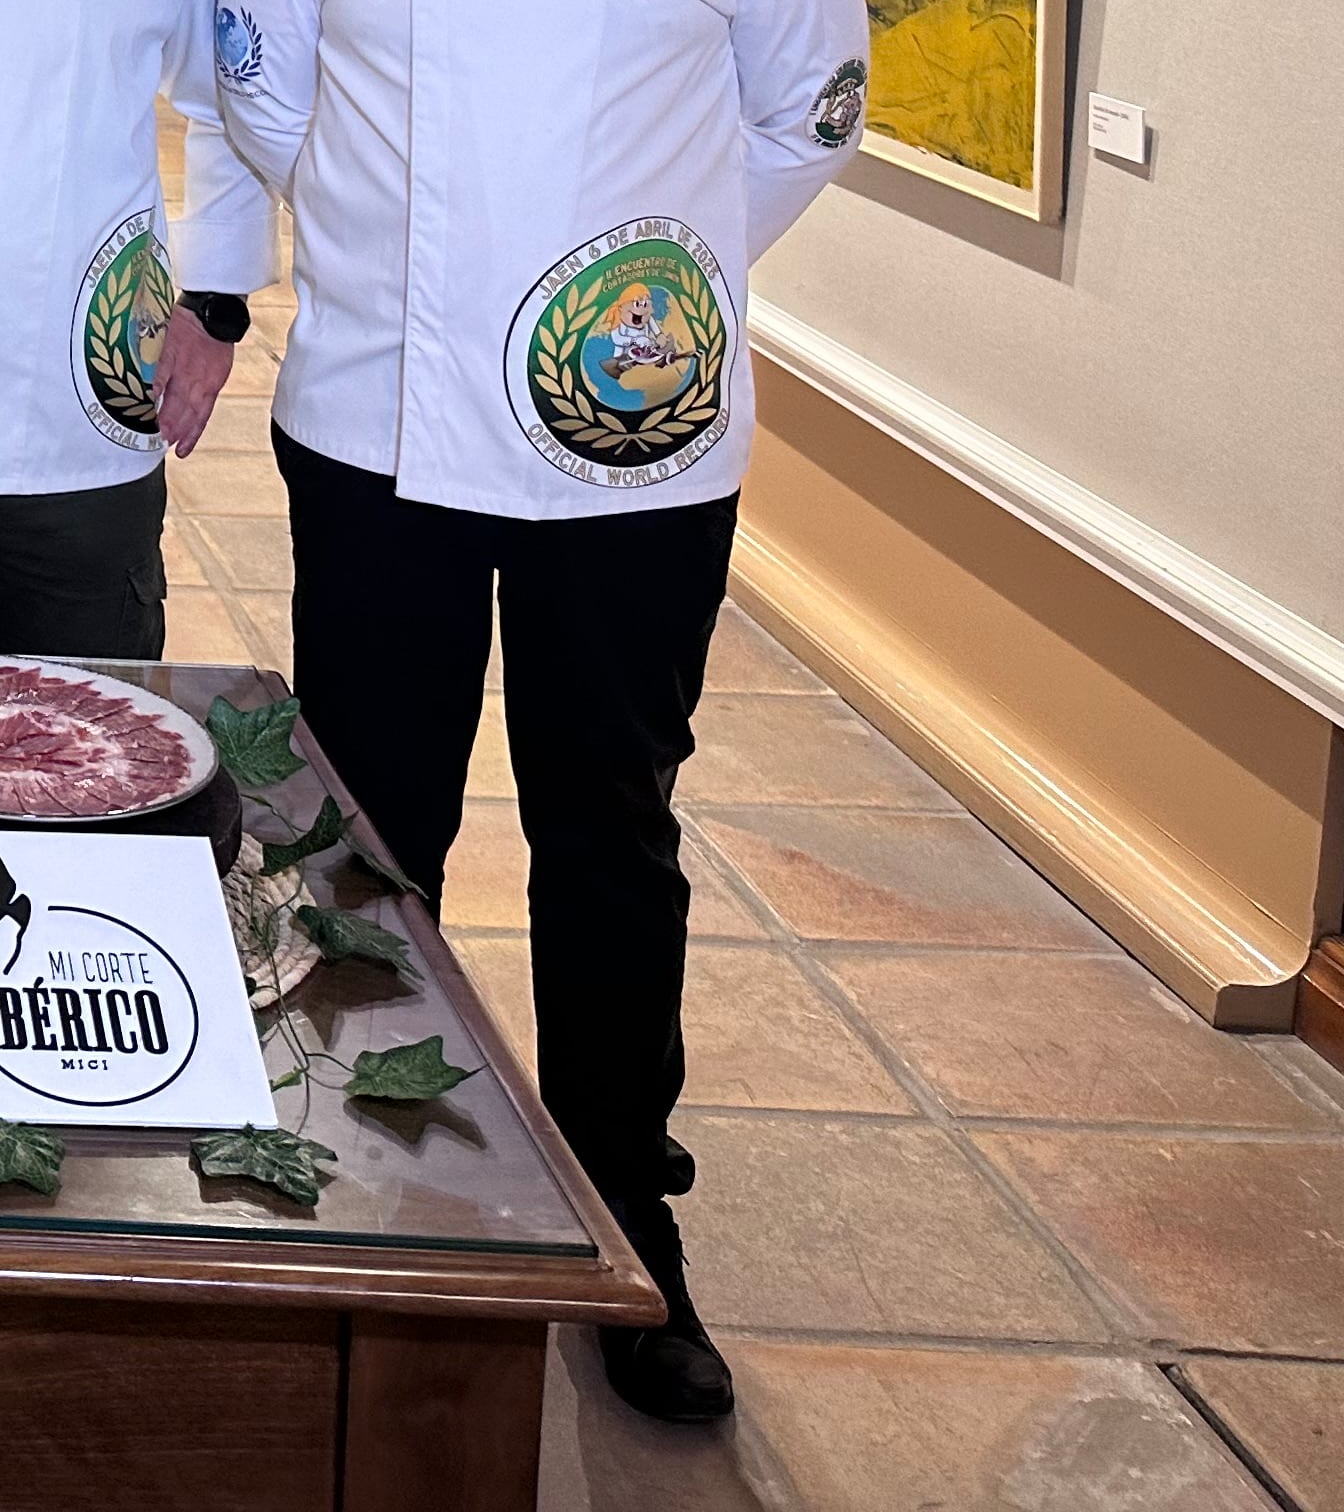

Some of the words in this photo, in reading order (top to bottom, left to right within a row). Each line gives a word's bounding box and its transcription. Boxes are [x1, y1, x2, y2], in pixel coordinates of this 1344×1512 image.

[87, 244, 117, 289] JAEN
[117, 232, 126, 247] 6
[126, 216, 145, 237] DE
[539, 255, 585, 301] JAEN
[588, 244, 602, 261] 6
[606, 227, 629, 250] DE
[634, 220, 673, 240] ABRIL
[677, 225, 692, 248] DE
[614, 256, 666, 276] ENCUENTRO
[88, 402, 140, 449] OFFICIAL
[528, 423, 597, 483] OFFICIAL
[607, 462, 671, 487] WORLD
[673, 407, 730, 472] RECORD
[48, 951, 75, 982] MI
[82, 952, 153, 984] CORTE
[61, 1059, 108, 1071] MICI
